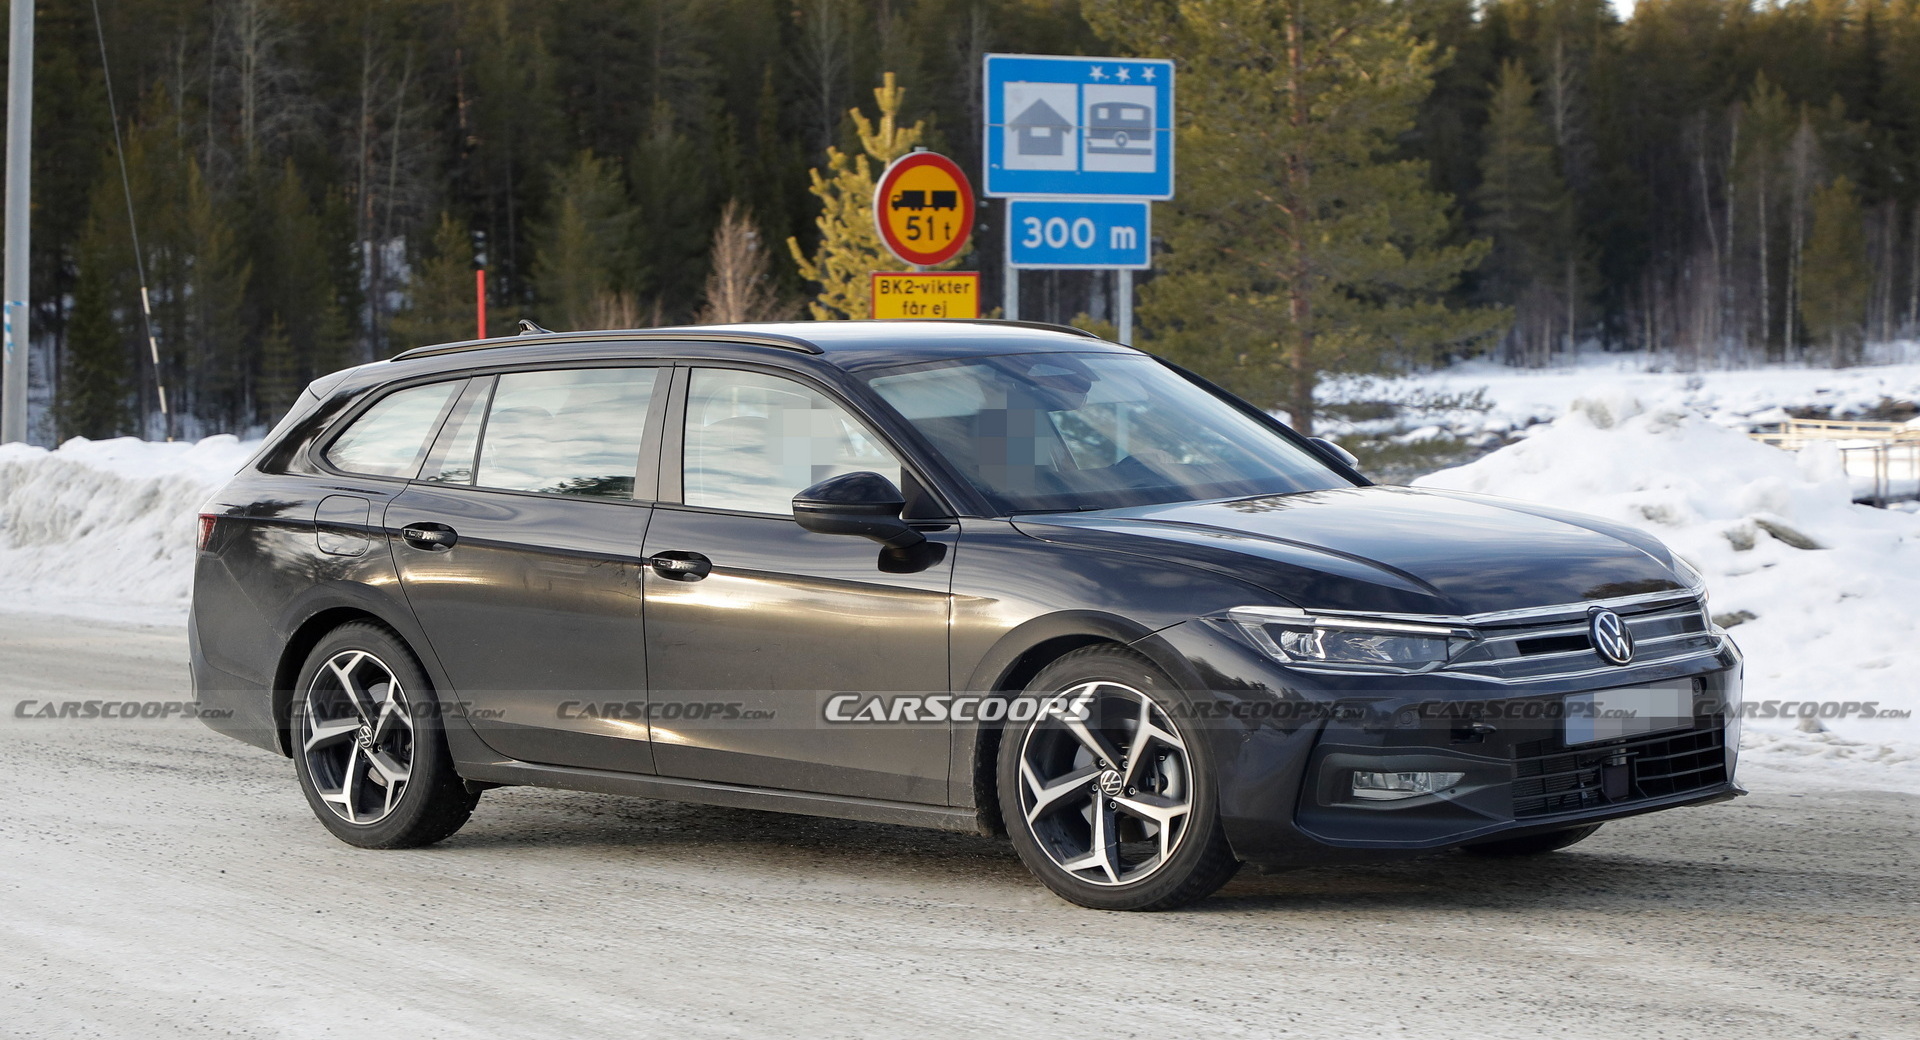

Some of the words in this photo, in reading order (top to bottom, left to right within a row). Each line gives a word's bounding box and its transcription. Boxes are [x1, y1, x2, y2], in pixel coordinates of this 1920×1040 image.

[906, 216, 934, 241] 51
[944, 222, 951, 241] t
[1022, 216, 1096, 249] 300
[1110, 226, 1137, 249] m
[880, 279, 970, 294] BK2-vikter
[902, 300, 927, 315] får
[932, 300, 948, 318] ej
